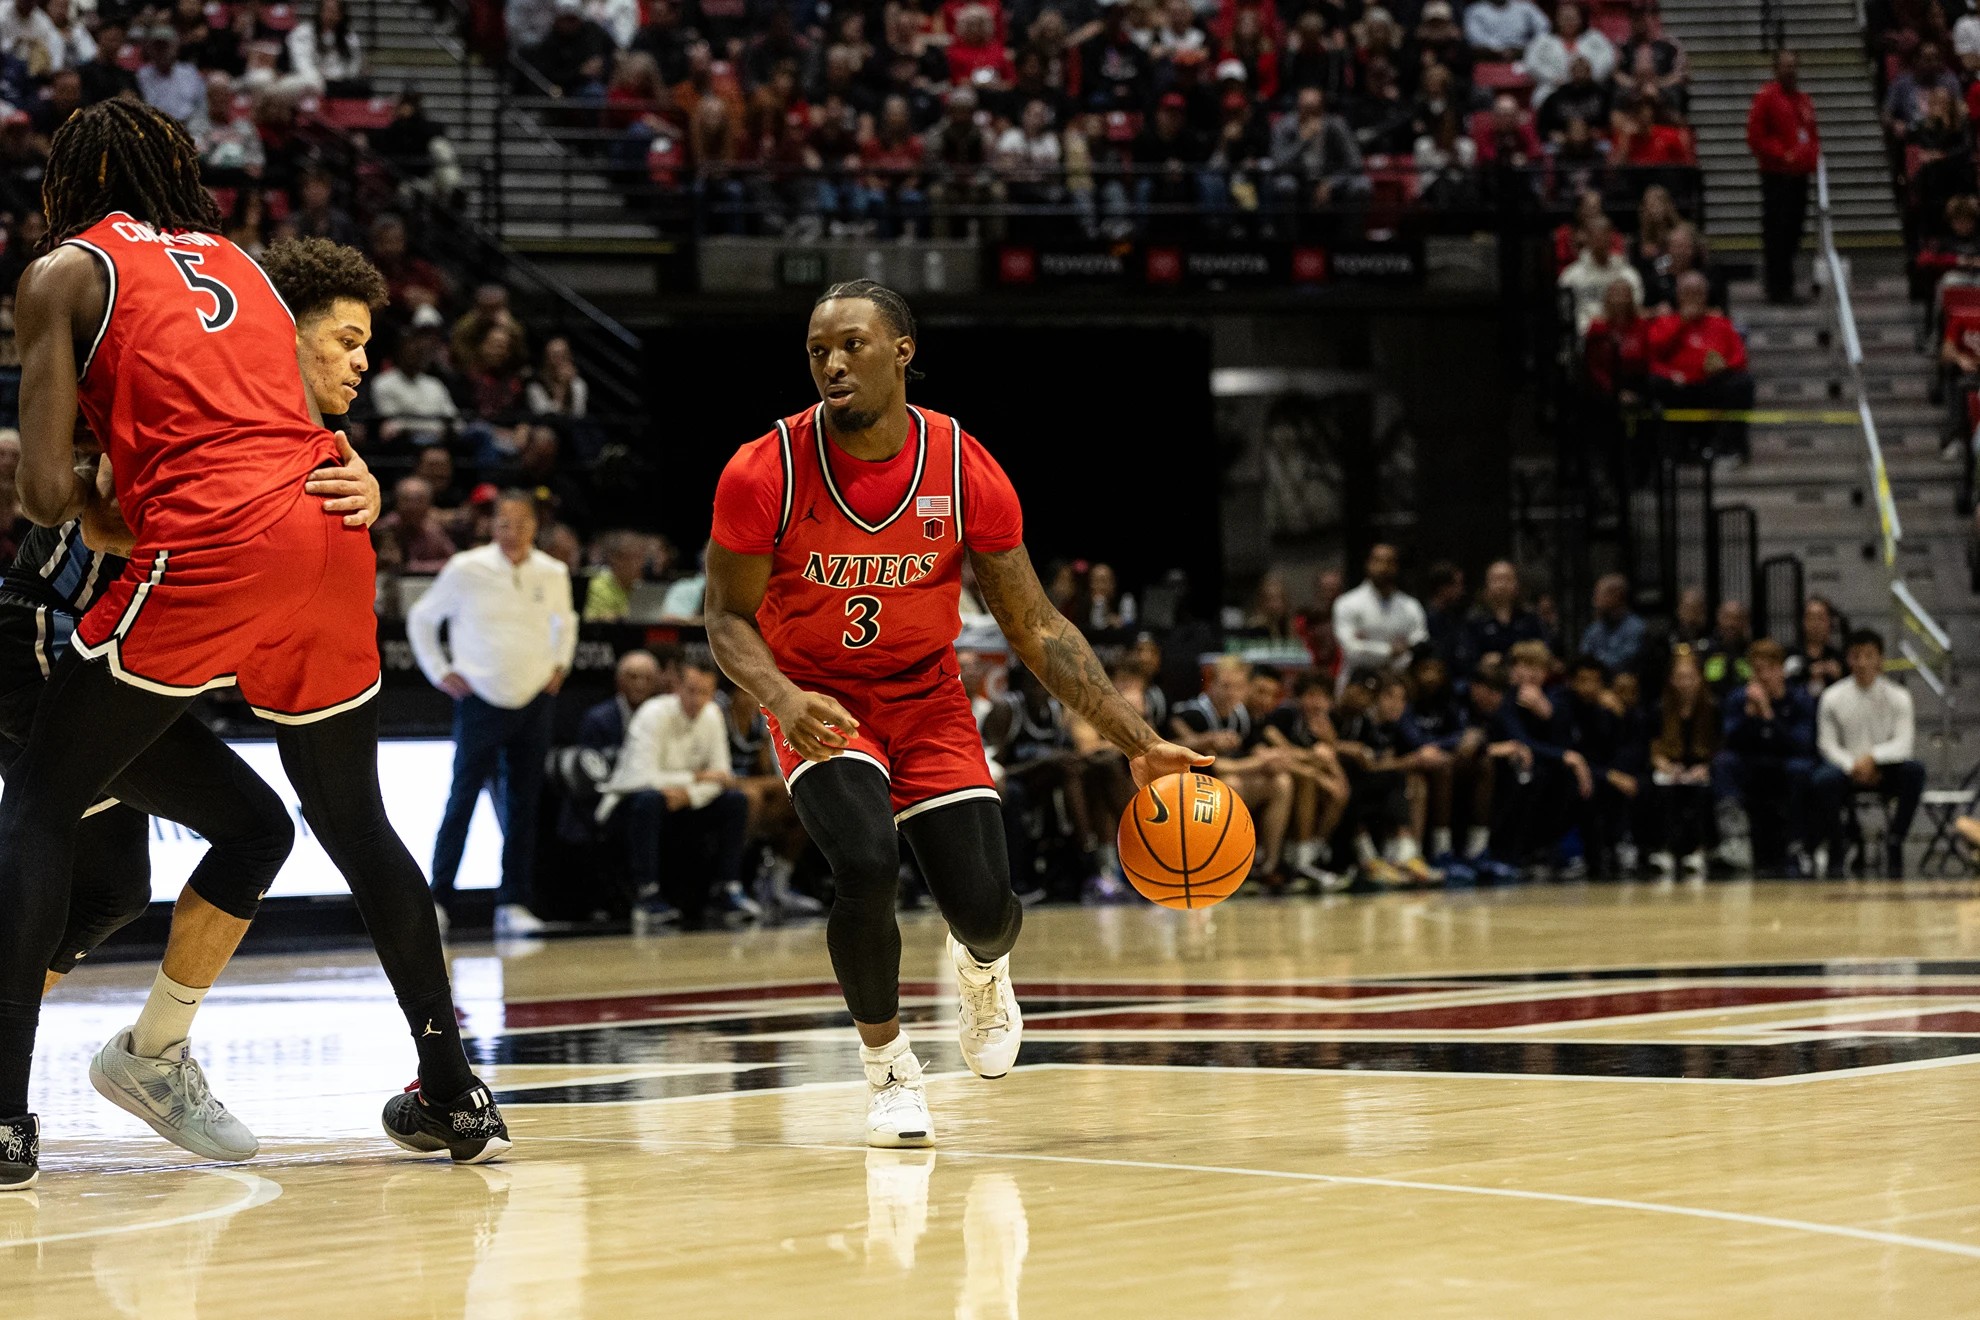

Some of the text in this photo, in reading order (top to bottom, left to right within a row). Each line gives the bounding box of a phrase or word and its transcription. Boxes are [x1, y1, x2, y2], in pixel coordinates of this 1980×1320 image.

[1042, 253, 1124, 275] TOYOTA
[1187, 253, 1270, 275] TOYOTA
[1332, 253, 1413, 275] TOYOTA
[164, 247, 239, 333] 5
[801, 551, 939, 589] AZTECS
[842, 594, 882, 649] 3
[1193, 774, 1215, 825] ELITE
